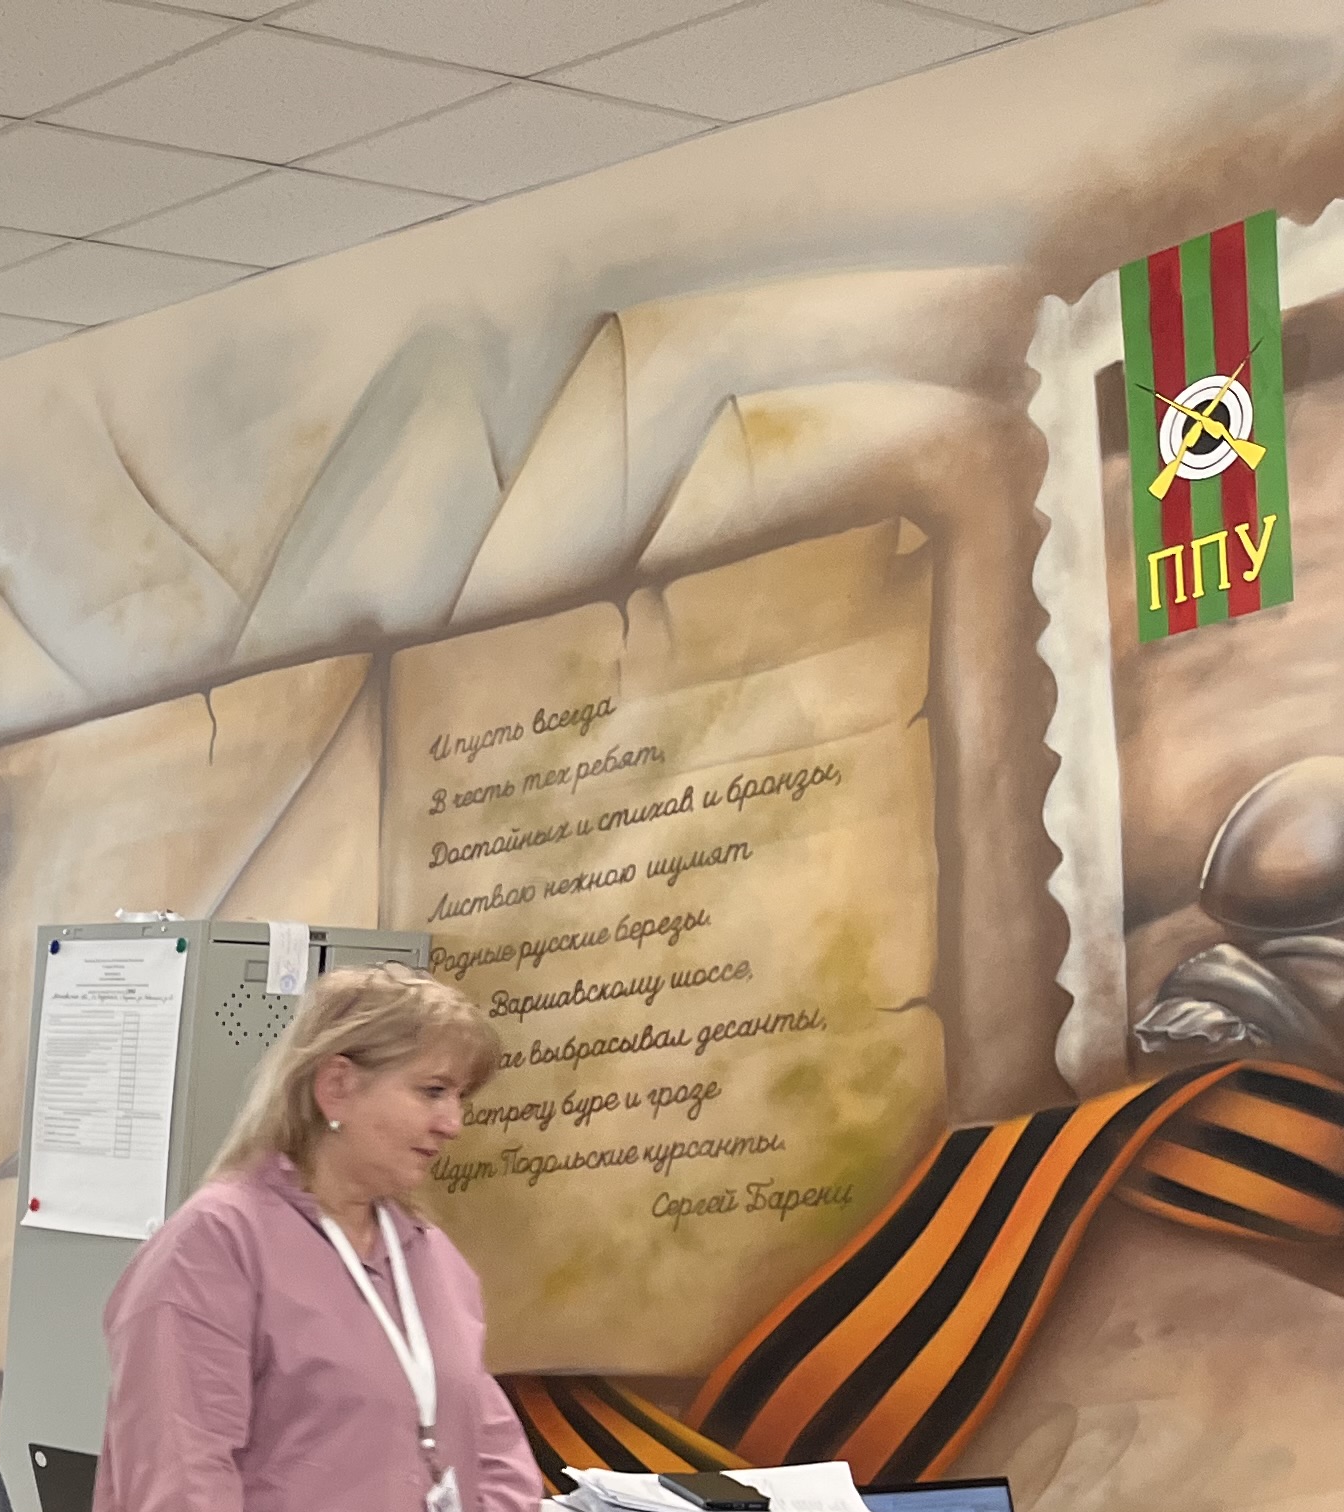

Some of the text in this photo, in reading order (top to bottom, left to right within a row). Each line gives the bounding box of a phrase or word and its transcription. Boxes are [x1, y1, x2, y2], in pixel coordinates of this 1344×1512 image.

[1147, 513, 1278, 612] ППУ
[454, 721, 524, 764] пусть
[532, 695, 618, 737] всегда
[428, 787, 448, 816] В
[452, 777, 516, 809] честь
[521, 766, 572, 795] тех
[428, 819, 574, 869] Достойных
[576, 818, 595, 837] и
[597, 784, 695, 832] стихов
[702, 789, 723, 809] и
[427, 841, 755, 923] Листвою нежною шумят
[429, 944, 517, 982] Родные
[515, 926, 611, 971] русские
[488, 975, 667, 1024] Варшавскому
[529, 1023, 694, 1071] выбрасывал
[462, 1080, 723, 1135] встречу буре и грозе
[429, 1153, 498, 1195] Идут
[499, 1143, 640, 1188] Подольские
[651, 1188, 740, 1233] Сергей
